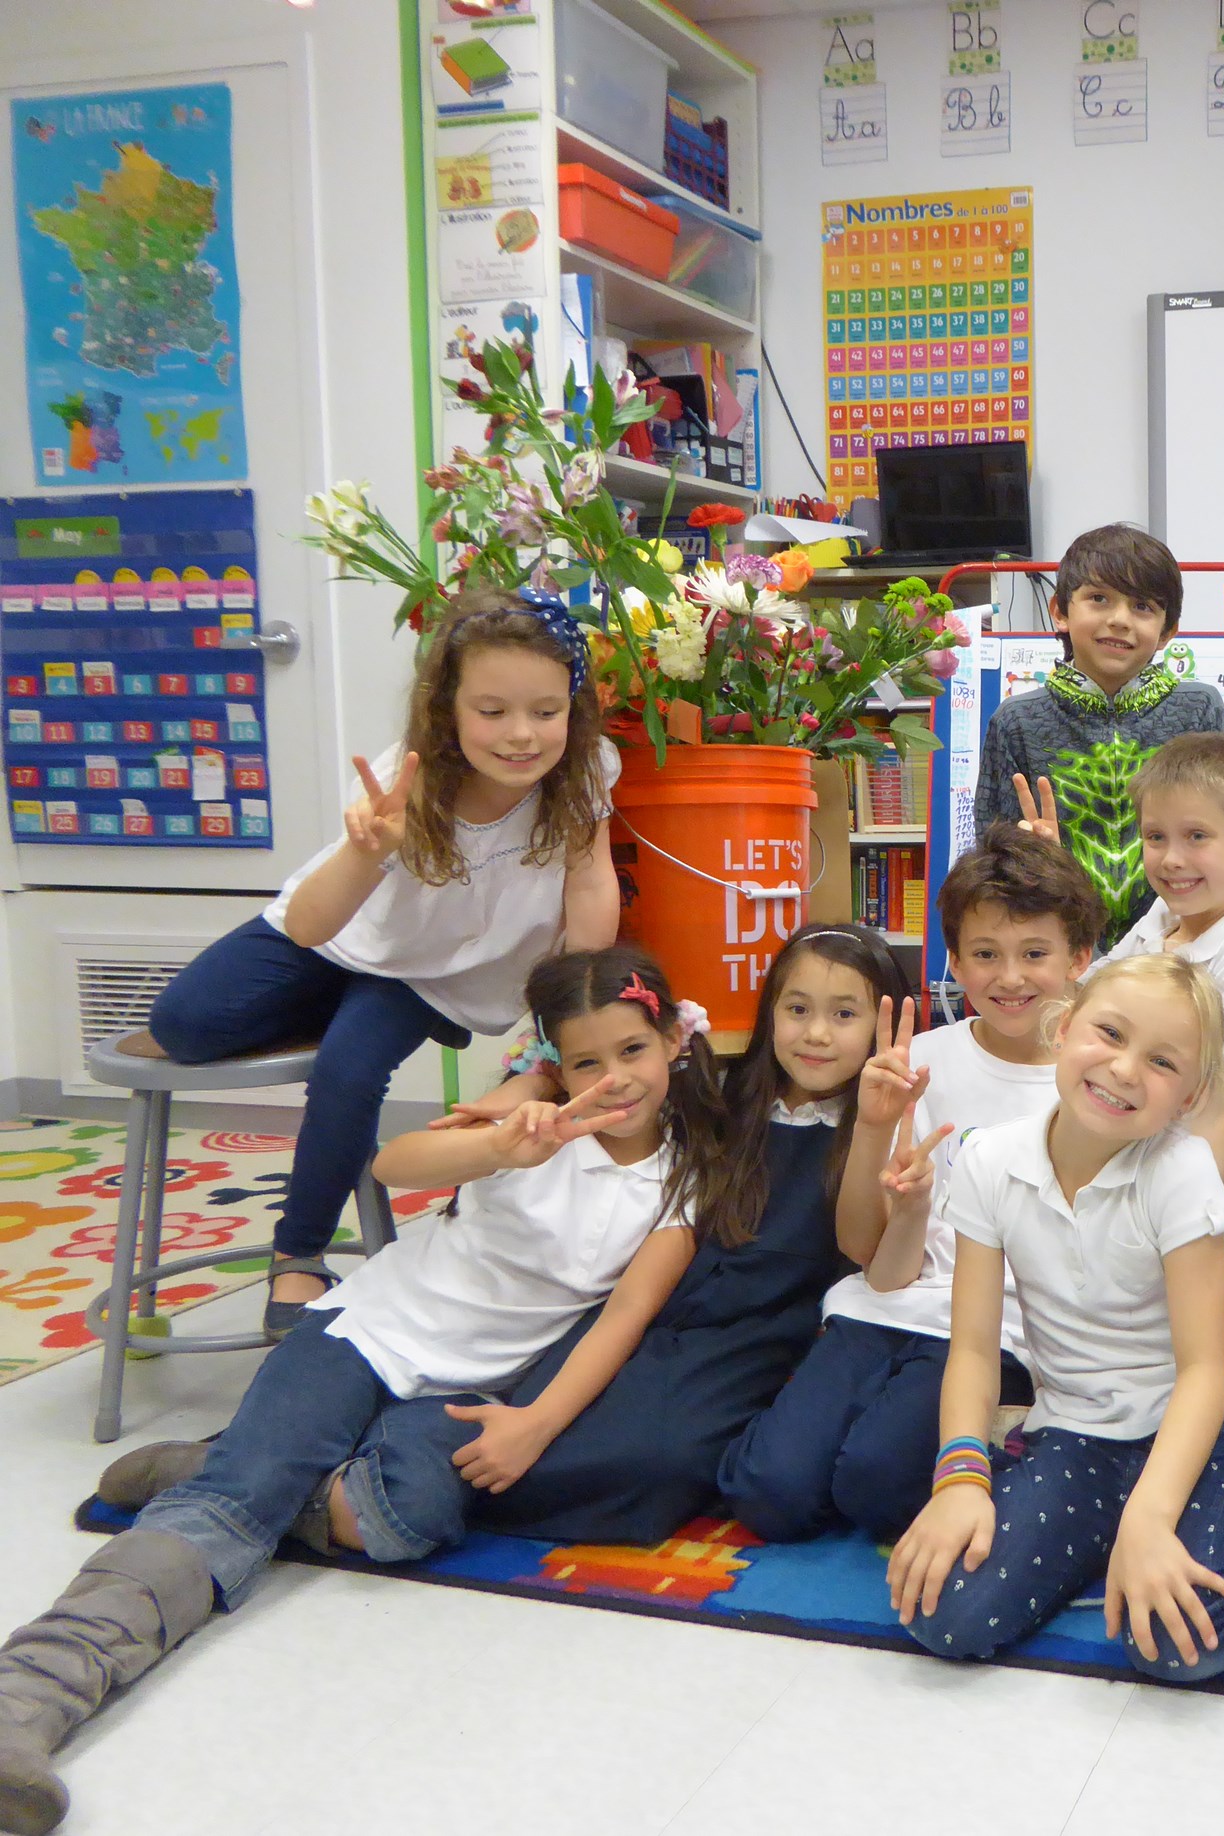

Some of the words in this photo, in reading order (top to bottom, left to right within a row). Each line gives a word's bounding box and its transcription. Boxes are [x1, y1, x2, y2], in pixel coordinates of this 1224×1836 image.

[1083, 0, 1136, 39] Cc
[952, 10, 998, 52] Bb
[825, 24, 876, 65] Aa
[1079, 75, 1133, 118] Cc
[945, 86, 1006, 130] Bb
[826, 99, 882, 142] Aa
[845, 198, 954, 225] Nombres
[956, 207, 970, 217] de
[991, 204, 1009, 215] 100
[994, 253, 1004, 264] 19
[1013, 251, 1025, 263] 20
[830, 293, 841, 304] 21
[850, 292, 863, 304] 22
[870, 291, 883, 302] 23
[890, 290, 903, 301] 24
[911, 288, 923, 300] 25
[932, 287, 944, 298] 26
[952, 285, 964, 297] 27
[973, 284, 985, 295] 28
[993, 283, 1005, 294] 29
[1013, 281, 1025, 292] 30
[1168, 297, 1195, 306] SMART
[831, 322, 841, 333] 31
[851, 321, 863, 331] 32
[871, 320, 883, 331] 33
[891, 319, 903, 330] 34
[912, 318, 923, 328] 35
[932, 316, 944, 327] 36
[953, 315, 964, 326] 37
[973, 314, 985, 325] 38
[994, 312, 1006, 323] 39
[1013, 310, 1025, 322] 40
[831, 351, 841, 362] 41
[851, 350, 863, 361] 42
[871, 349, 883, 360] 43
[891, 349, 904, 359] 44
[912, 347, 924, 358] 45
[932, 346, 945, 356] 46
[952, 344, 965, 355] 47
[973, 343, 986, 354] 48
[993, 342, 1006, 353] 49
[1013, 340, 1025, 351] 50
[832, 380, 842, 390] 51
[852, 379, 863, 389] 52
[872, 378, 884, 389] 53
[892, 378, 904, 387] 54
[913, 376, 924, 386] 55
[933, 375, 945, 385] 56
[954, 374, 965, 384] 57
[974, 372, 986, 383] 58
[994, 372, 1005, 382] 59
[1013, 369, 1025, 381] 60
[832, 409, 843, 419] 61
[852, 408, 864, 419] 62
[872, 406, 884, 418] 63
[892, 406, 905, 417] 64
[912, 405, 925, 416] 65
[933, 404, 945, 415] 66
[953, 403, 965, 414] 67
[973, 402, 986, 413] 68
[993, 400, 1006, 412] 69
[1013, 399, 1025, 410] 70
[833, 437, 843, 448] 71
[853, 436, 865, 447] 72
[873, 436, 885, 446] 73
[893, 435, 905, 445] 74
[913, 434, 926, 445] 75
[934, 433, 945, 444] 76
[953, 432, 966, 443] 77
[974, 430, 986, 441] 78
[993, 429, 1006, 440] 79
[1013, 428, 1026, 439] 80
[833, 466, 844, 477] 81
[853, 465, 866, 476] 82
[52, 527, 83, 546] May
[204, 630, 212, 646] 1
[18, 679, 28, 693] 3
[57, 679, 67, 692] 4
[94, 678, 104, 692] 5
[168, 677, 179, 692] 7
[235, 676, 246, 691] 9
[952, 686, 976, 699] 1089
[951, 698, 974, 710] 1090
[50, 725, 68, 740] 11
[89, 725, 107, 740] 12
[129, 724, 148, 739] 13
[167, 724, 184, 739] 14
[196, 723, 214, 738] 15
[15, 769, 33, 784] 17
[93, 770, 110, 785] 19
[132, 771, 151, 786] 20
[166, 771, 185, 786] 21
[240, 771, 259, 786] 23
[56, 816, 73, 830] 25
[130, 818, 149, 832] 27
[207, 818, 225, 833] 29
[723, 838, 803, 871] LET'S
[725, 879, 802, 944] DO
